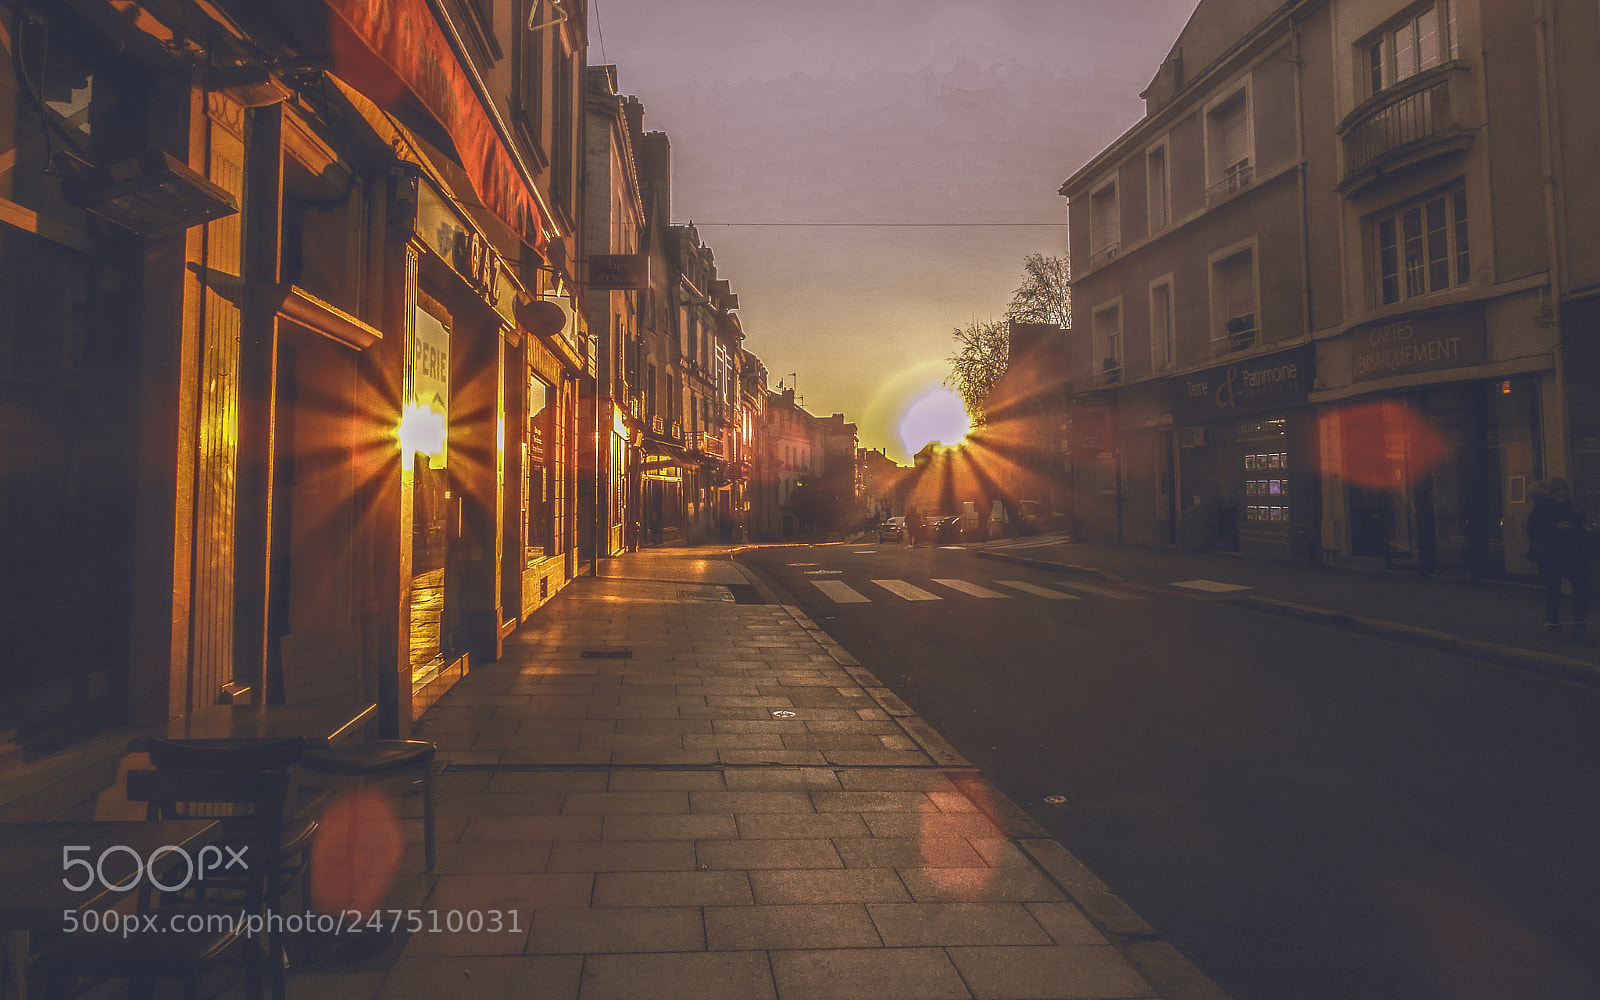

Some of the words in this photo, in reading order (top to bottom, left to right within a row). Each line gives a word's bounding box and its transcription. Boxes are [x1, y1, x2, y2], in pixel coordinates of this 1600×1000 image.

[597, 273, 638, 283] d'Orient
[1369, 318, 1414, 347] CARTES
[1186, 381, 1209, 398] Terre
[1215, 365, 1243, 408] &
[1243, 362, 1298, 388] Patrimoine
